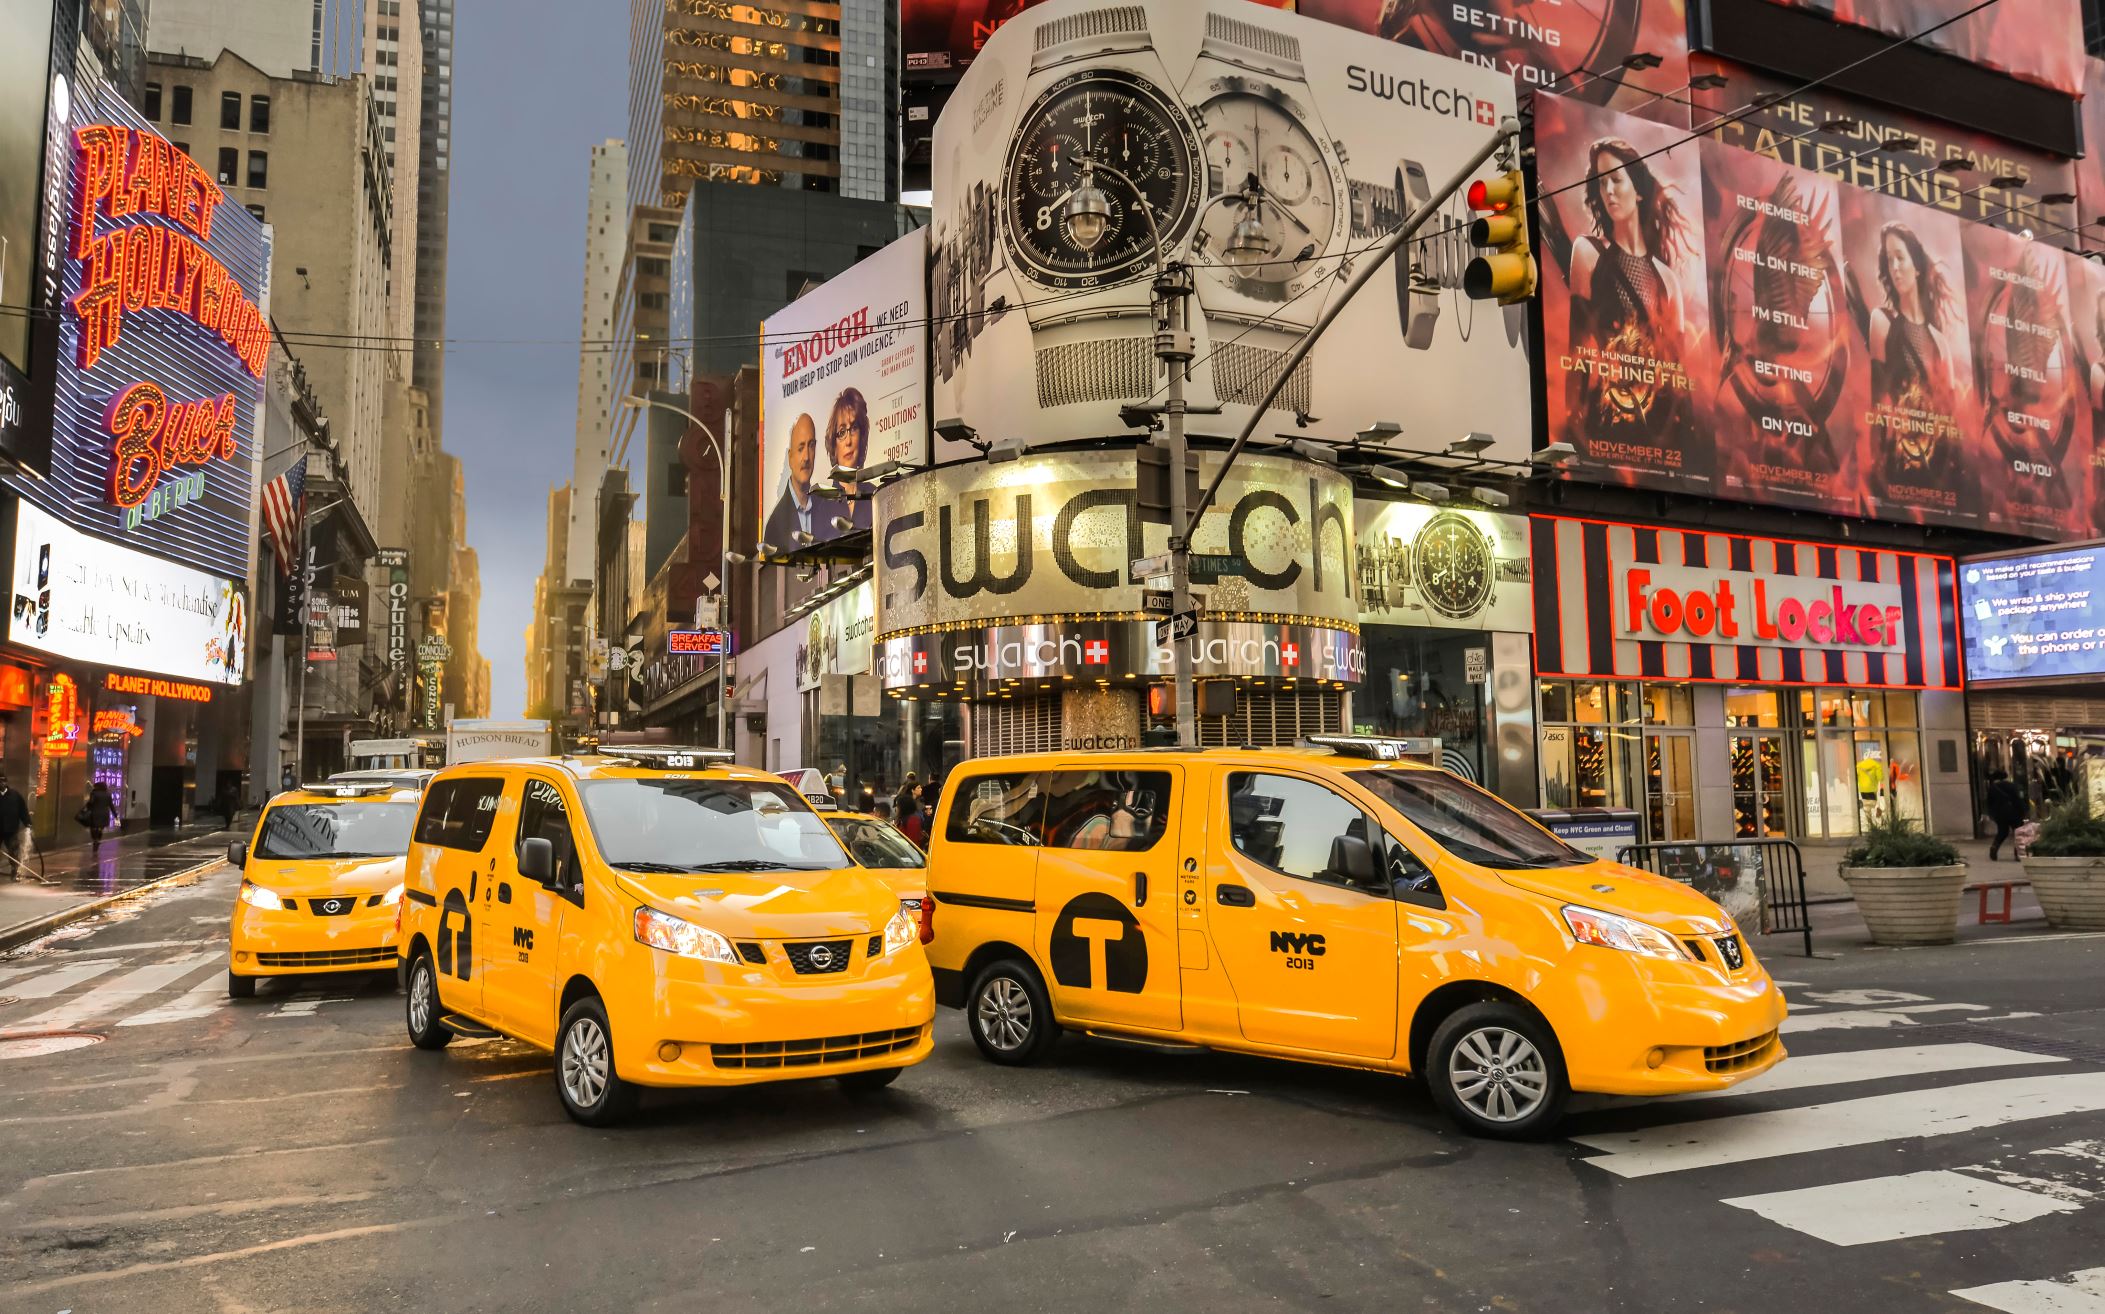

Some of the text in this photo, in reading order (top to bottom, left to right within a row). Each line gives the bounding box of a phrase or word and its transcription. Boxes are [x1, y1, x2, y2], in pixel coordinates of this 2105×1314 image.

[1453, 3, 1561, 47] BETTING
[1461, 50, 1556, 88] ON YOU
[1134, 77, 1153, 91] 700
[1346, 65, 1472, 122] swatch
[1168, 104, 1184, 121] 400
[1185, 132, 1197, 151] 300
[1755, 91, 1815, 127] THE
[1945, 143, 2033, 185] GAMES
[1714, 119, 2066, 233] CATCHING FIRE
[75, 124, 224, 259] PLANET
[1037, 206, 1051, 230] 8
[1736, 194, 1810, 226] REMEMBER
[1129, 260, 1147, 273] 140
[1734, 247, 1766, 267] GIRL
[1767, 256, 1787, 272] ON
[1026, 267, 1039, 280] 100
[1054, 277, 1068, 287] 110
[1081, 276, 1099, 286] 120
[1989, 267, 2045, 290] REMEMBER
[74, 223, 272, 378] HOLLYWOOD
[876, 312, 888, 330] WE
[890, 301, 909, 323] NEED
[1752, 305, 1809, 330] I'M STILL
[1988, 313, 2014, 329] GIRL
[2015, 319, 2031, 332] ON
[1576, 346, 1684, 372] THE HUNGER GAMES
[782, 377, 799, 398] YOUR
[799, 372, 815, 393] HELP
[817, 368, 826, 383] TO
[826, 360, 843, 378] STOP
[844, 353, 858, 368] GUN
[1560, 356, 1696, 392] CATCHING FIRE
[1754, 360, 1812, 383] BETTING
[2004, 363, 2047, 384] I'M STILL
[1896, 405, 1927, 420] HUNGER
[2007, 411, 2051, 431] BETTING
[1761, 416, 1812, 437] ON YOU
[1864, 412, 1964, 440] CATCHING FIRE
[1589, 440, 1681, 461] NOVEMBER 22
[2013, 460, 2052, 477] ON YOU
[151, 471, 205, 520] BEPPO
[1888, 484, 1943, 499] NOVEMBER
[1202, 559, 1229, 572] TIMES
[1982, 567, 1993, 575] We
[1995, 565, 2014, 574] make
[2015, 563, 2028, 572] gift
[1152, 597, 1170, 608] ONE
[1625, 568, 1902, 647] Foot Locker
[1992, 598, 2008, 607] We
[2009, 596, 2033, 607] wrap
[2044, 593, 2065, 602] ship
[2067, 590, 2090, 602] your
[1998, 599, 2088, 616] package anywhere
[845, 616, 870, 642] swatch
[1173, 619, 1189, 633] WAY
[2011, 628, 2095, 644] You can order
[427, 635, 444, 645] PUB
[671, 634, 723, 643] BREAKFAS
[671, 643, 711, 651] SERVED
[2018, 645, 2039, 655] the
[2041, 641, 2080, 655] phone
[2082, 640, 2096, 650] or
[954, 634, 1082, 671] swatch
[108, 673, 211, 702] PLANET HOLLYWOOD
[456, 735, 540, 748] HUDSON BREAD
[1064, 734, 1127, 750] swatch
[1547, 732, 1565, 741] asics
[667, 755, 694, 767] 2013
[1553, 827, 1569, 835] Keep
[1584, 825, 1601, 833] Green
[1615, 824, 1633, 832] Clean!
[513, 926, 533, 950] NYC
[1270, 930, 1326, 956] NYC
[518, 951, 529, 964] 2013
[1072, 917, 1123, 990] T
[1286, 957, 1315, 971] 2013
